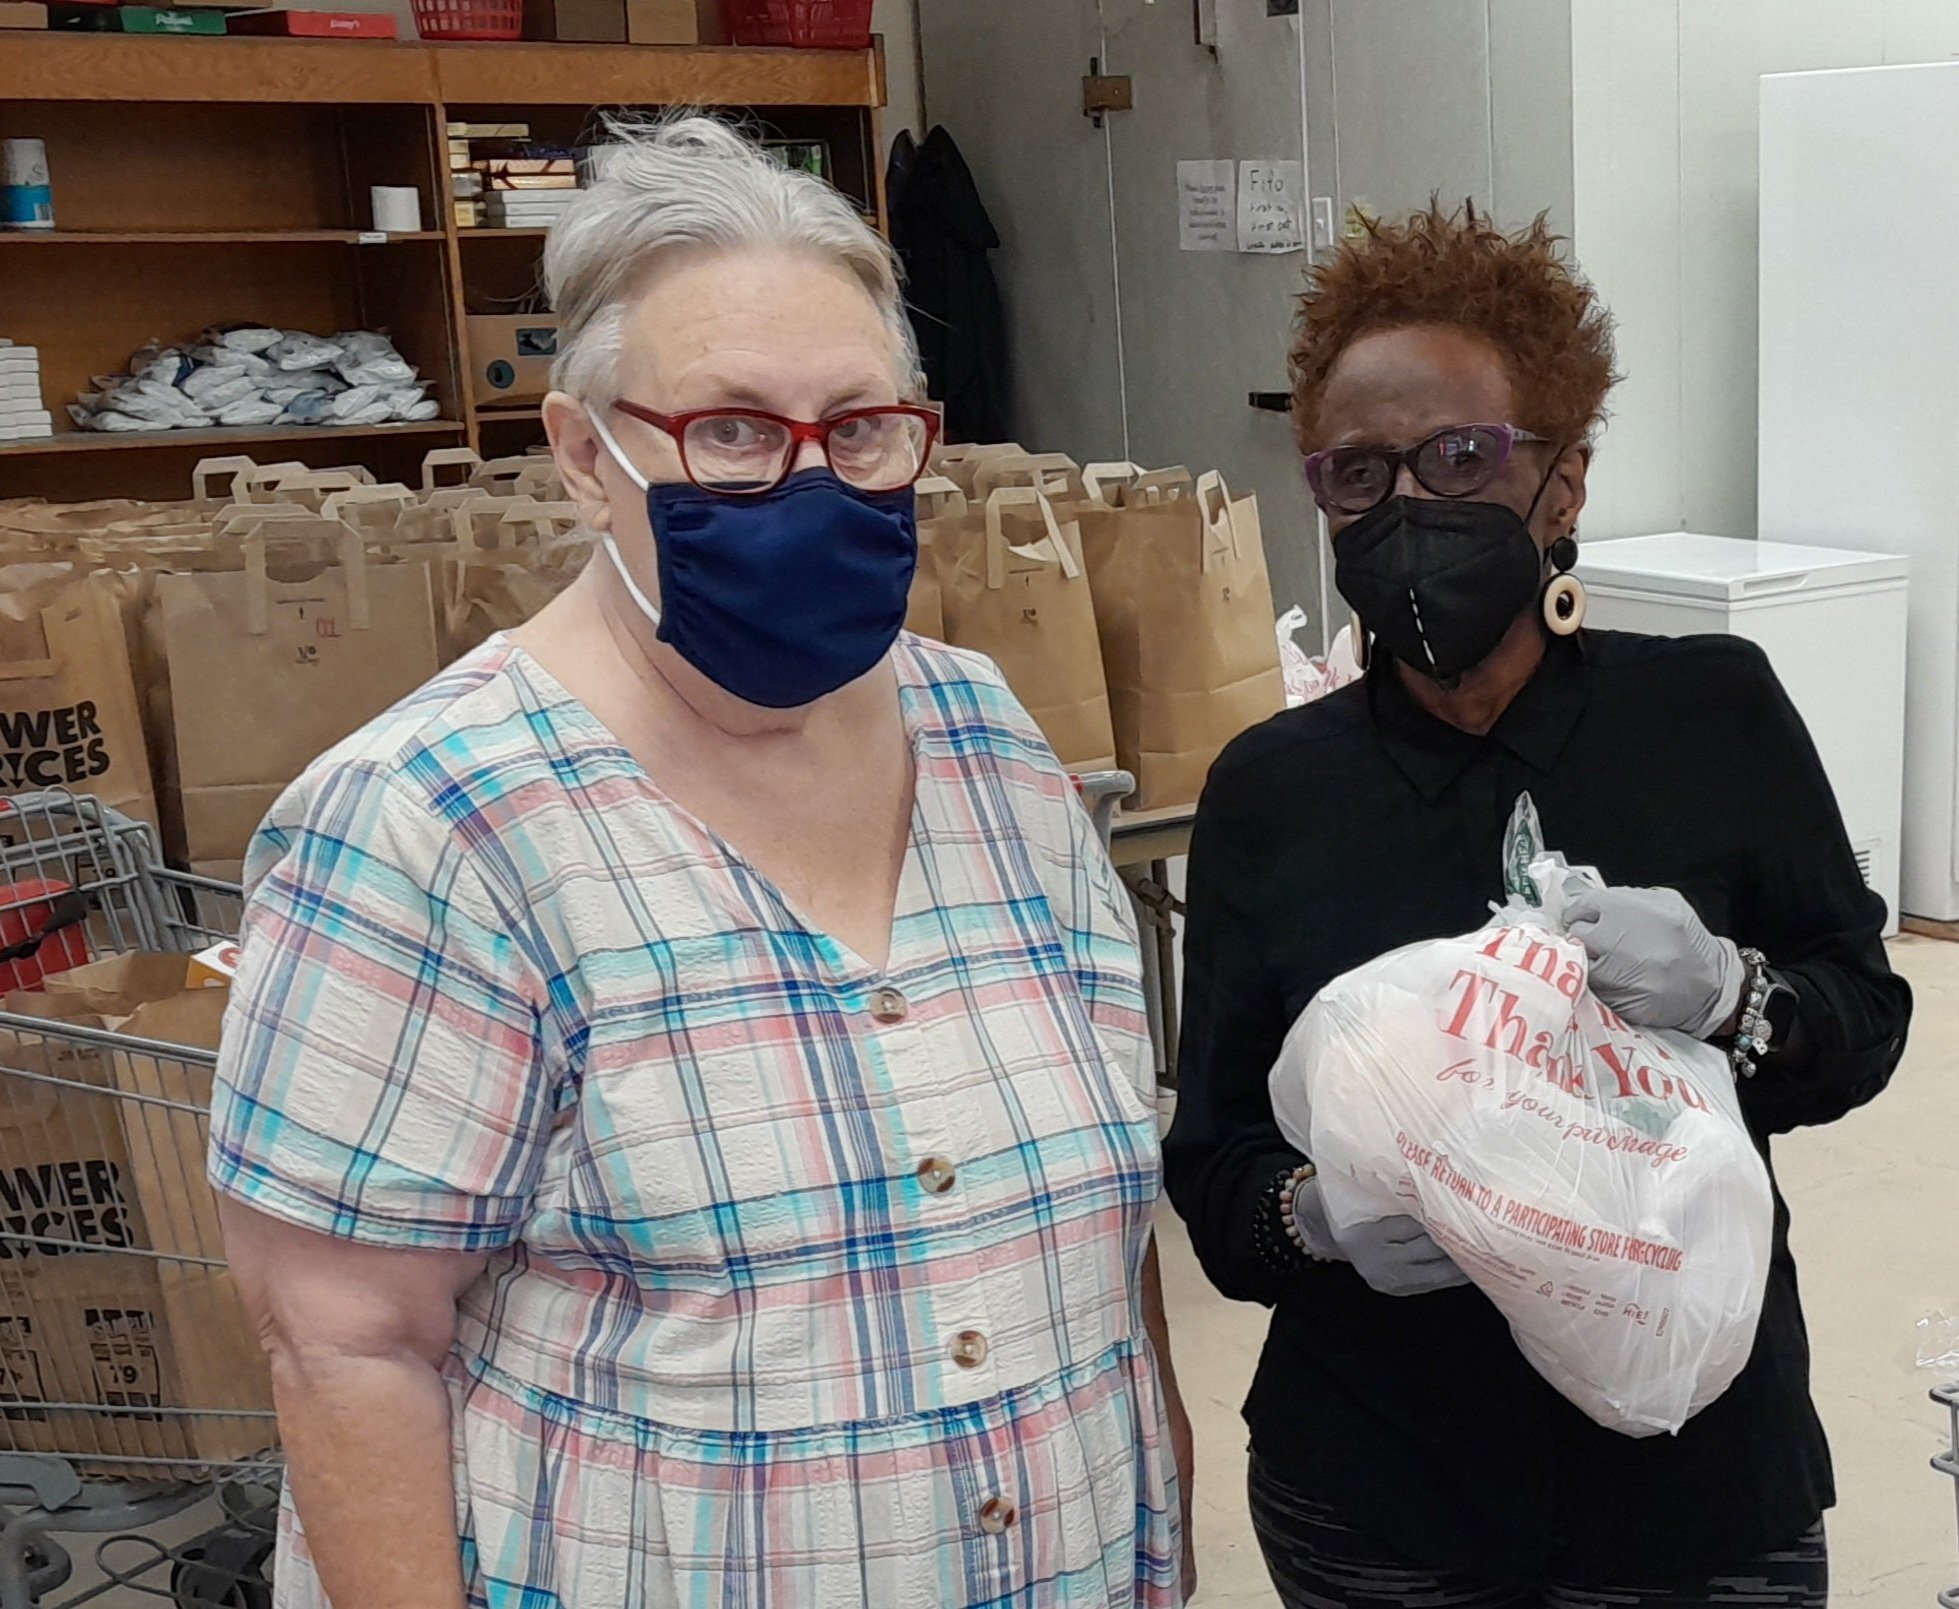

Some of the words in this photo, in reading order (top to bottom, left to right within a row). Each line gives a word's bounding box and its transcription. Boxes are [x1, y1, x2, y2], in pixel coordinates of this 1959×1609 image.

[1436, 1058, 1496, 1091] for
[1500, 1089, 1565, 1130] your
[1590, 1042, 1713, 1116] You
[1475, 1183, 1493, 1211] TO
[1490, 1194, 1503, 1219] A
[1502, 1199, 1588, 1250] PARTICIPATING
[1587, 1228, 1622, 1259] STORE
